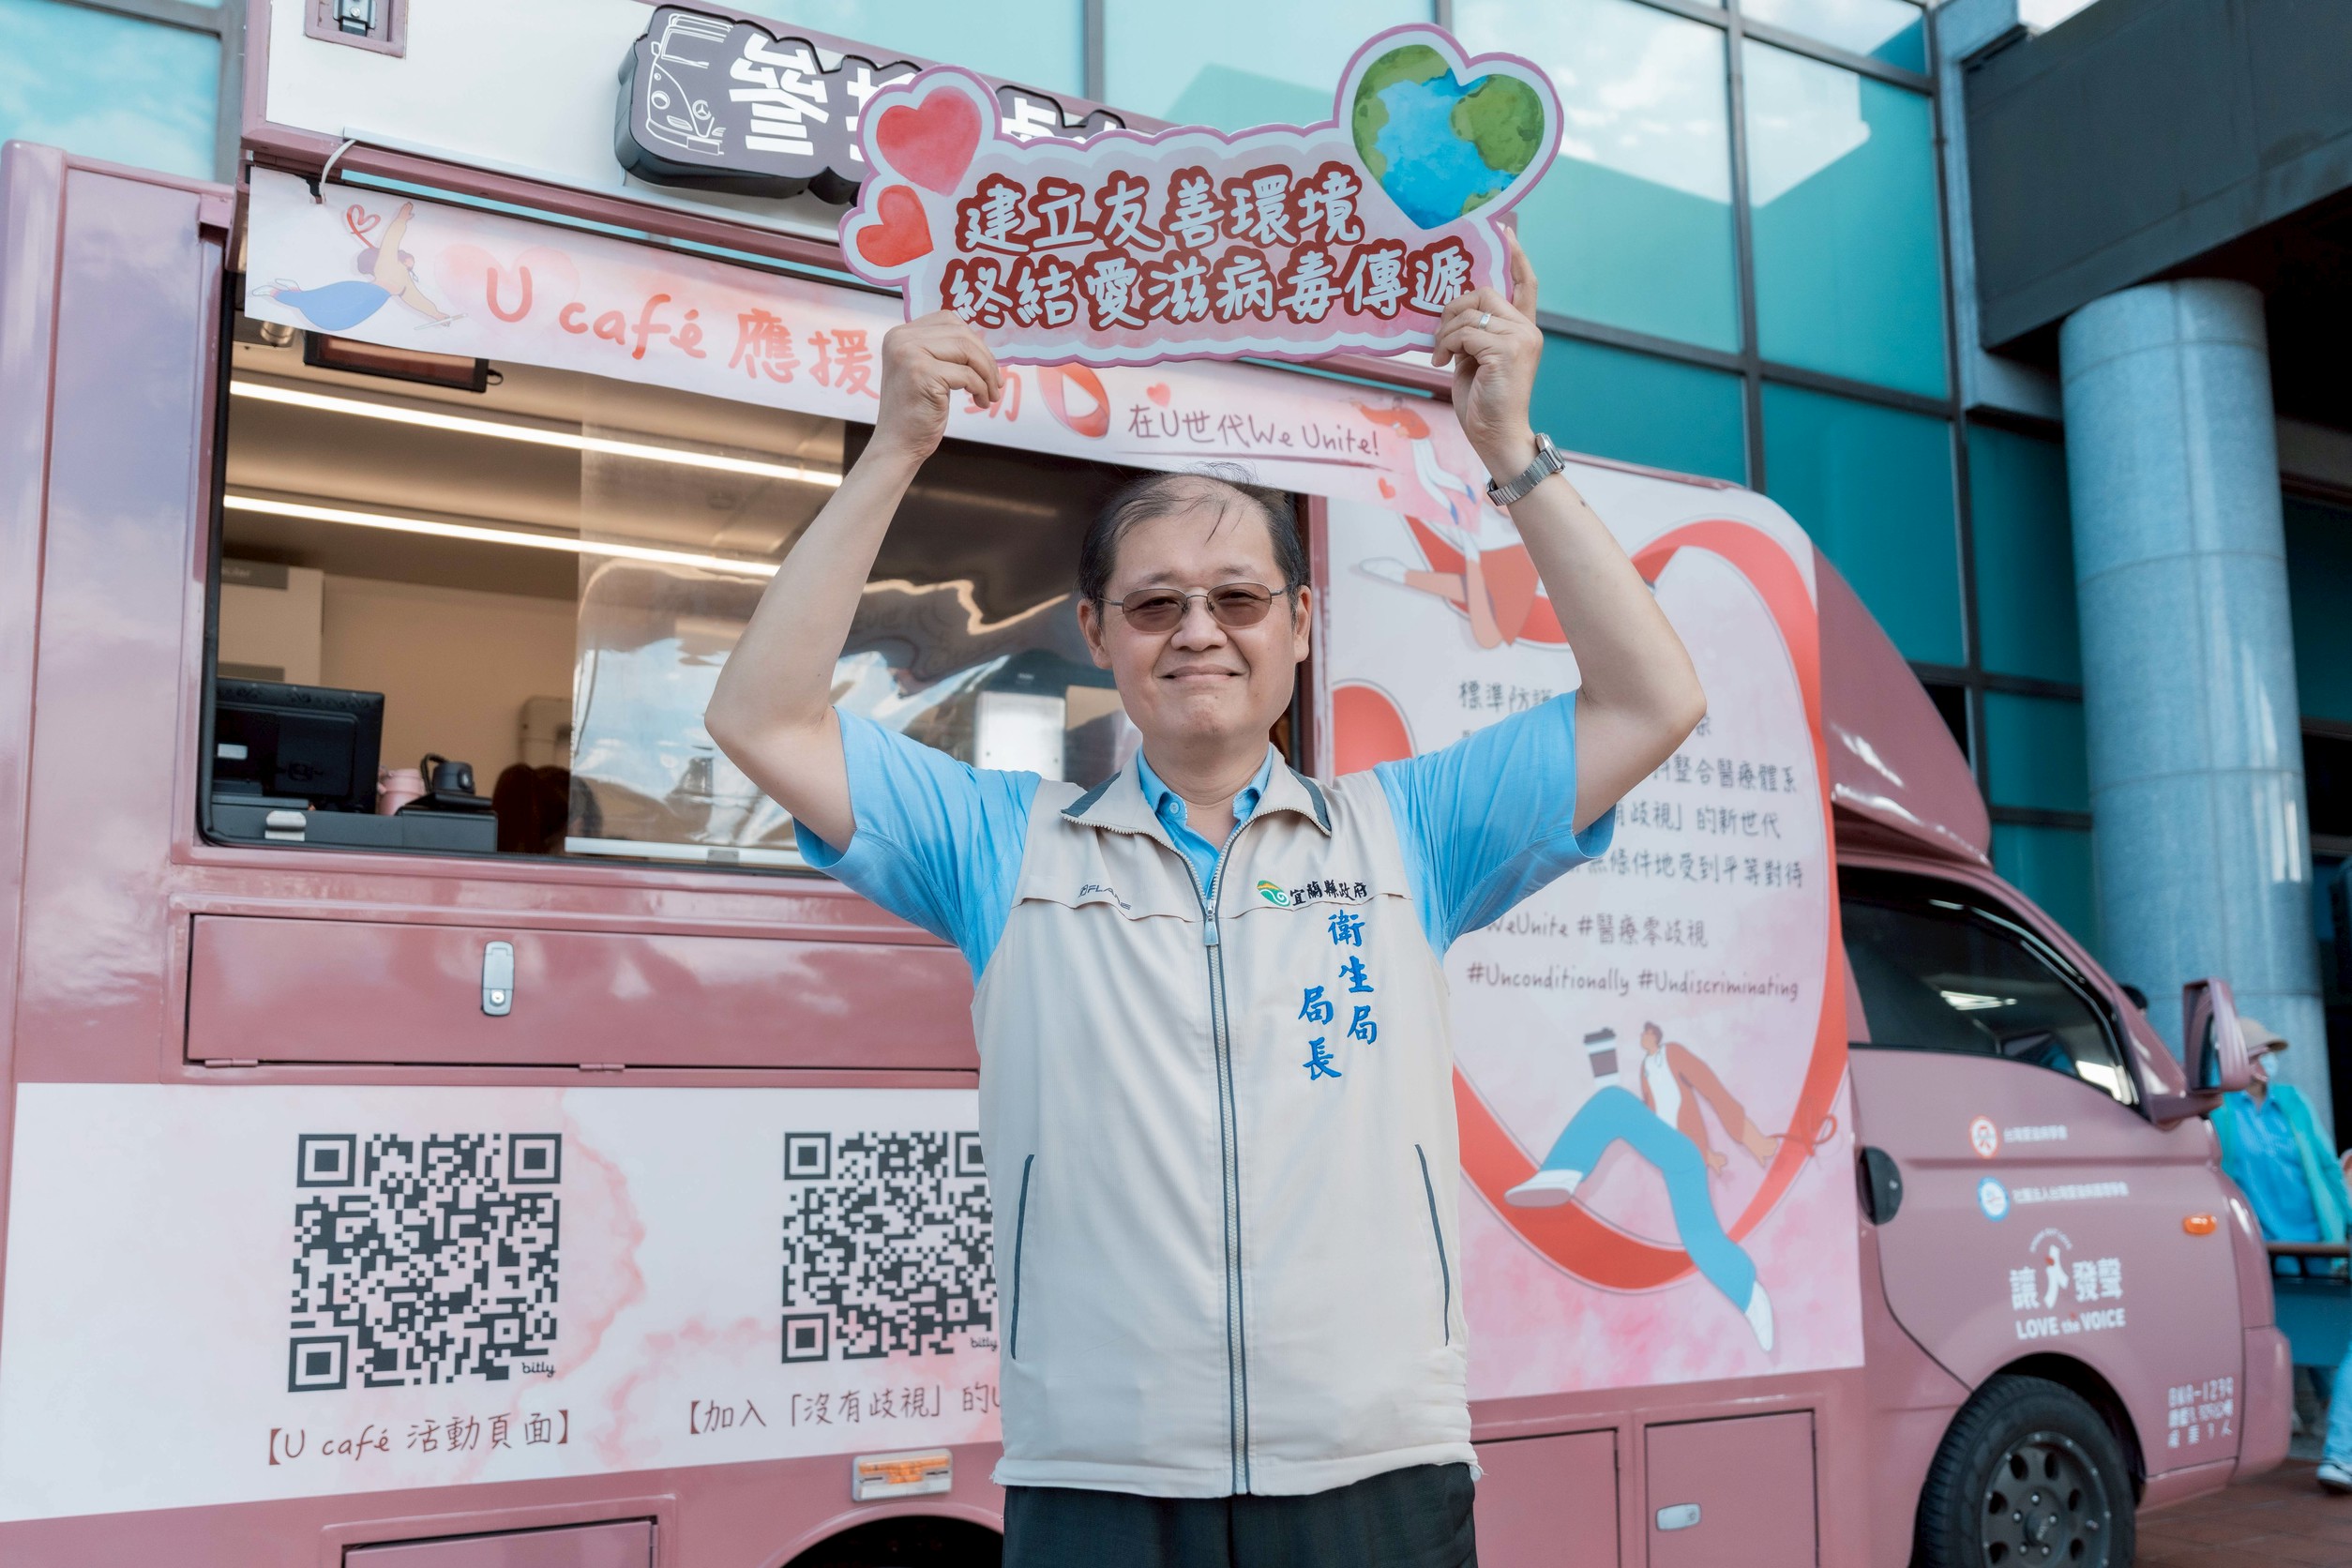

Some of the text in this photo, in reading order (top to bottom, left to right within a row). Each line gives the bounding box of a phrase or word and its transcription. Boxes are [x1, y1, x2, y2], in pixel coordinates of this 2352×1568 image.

[962, 169, 1365, 254] 建立友善環境
[947, 243, 1472, 328] 終結愛滋病毒傳遞
[486, 266, 533, 324] U
[559, 293, 709, 361] café
[1302, 423, 1380, 458] Unite!
[1289, 880, 1369, 907] 宜蘭縣政府
[1576, 912, 1710, 948] #醫療零歧視
[1326, 909, 1379, 1046] 衛生局
[1467, 961, 1800, 1002] #Unconditionally #Undiscriminating
[1298, 985, 1343, 1081] 局長
[2015, 1316, 2060, 1340] LOVE
[2080, 1307, 2127, 1331] VOICE
[970, 1335, 999, 1351] bitly
[521, 1361, 556, 1379] bitly
[322, 1424, 390, 1462] café
